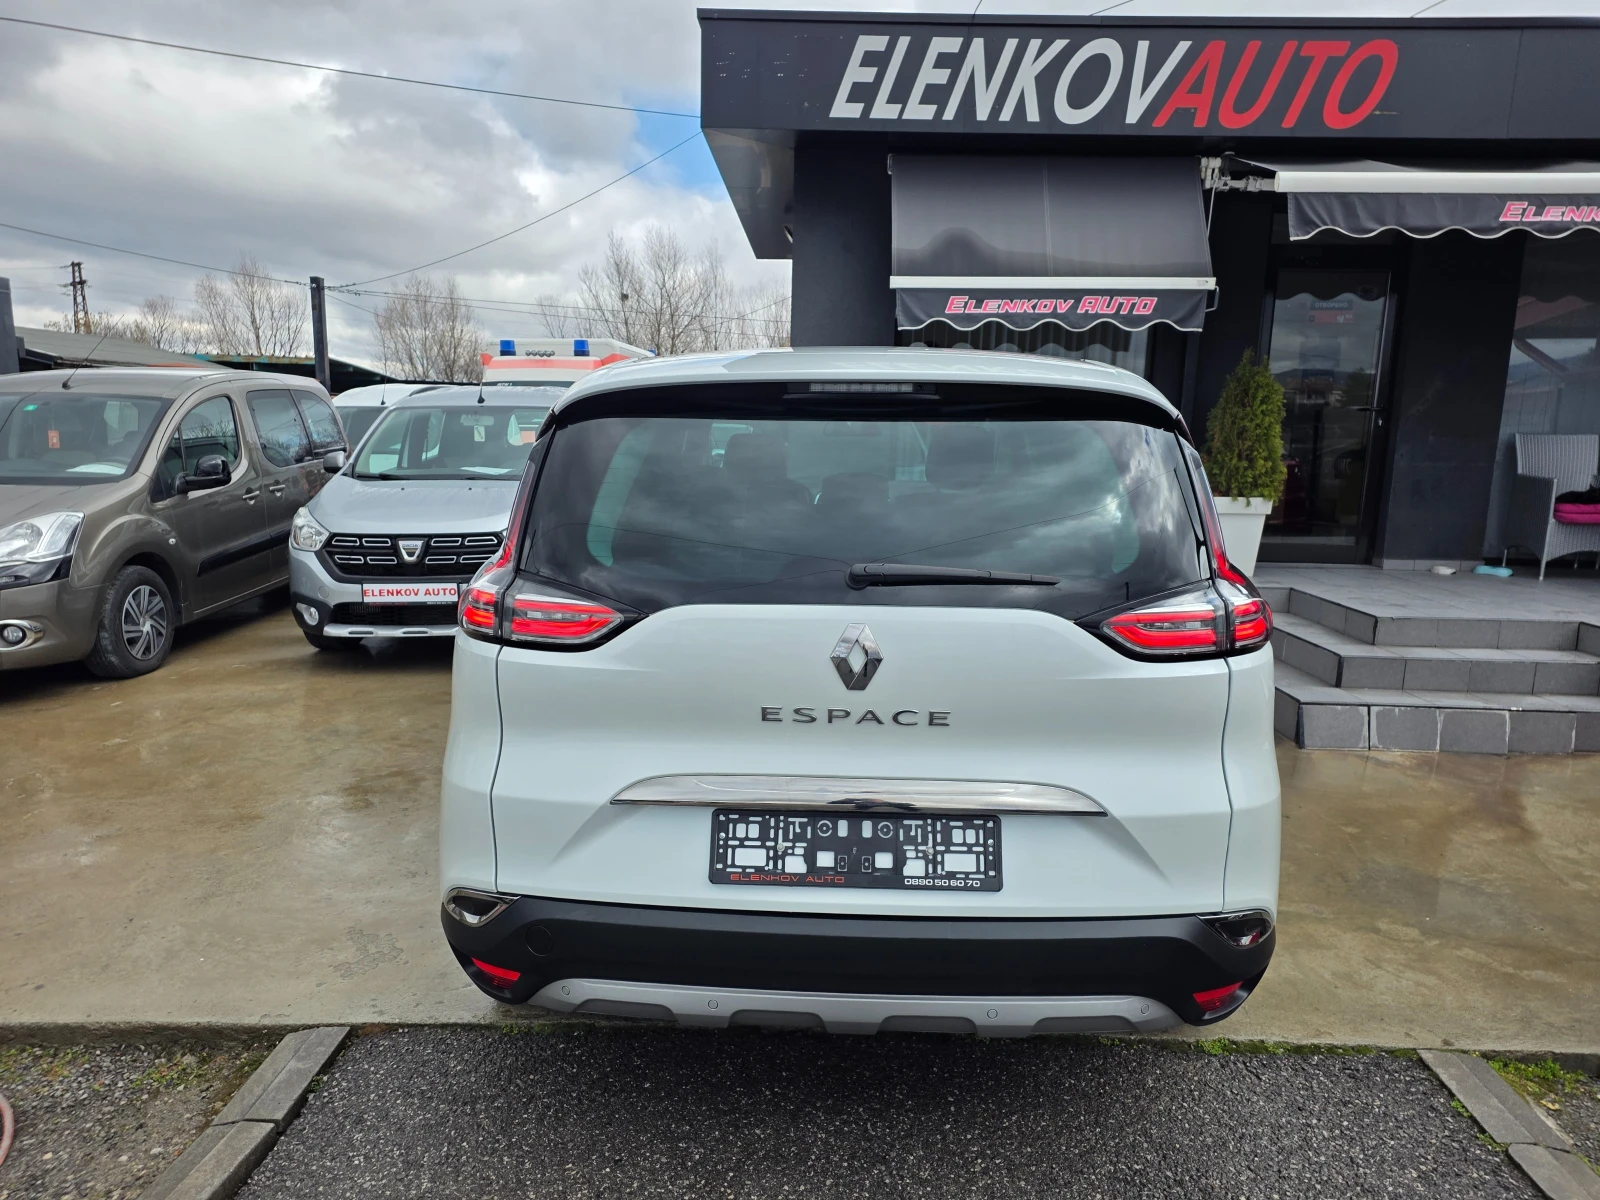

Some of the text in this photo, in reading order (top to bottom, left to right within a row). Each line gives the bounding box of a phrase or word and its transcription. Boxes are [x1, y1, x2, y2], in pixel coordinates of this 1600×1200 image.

[1077, 296, 1158, 315] AUTO
[363, 588, 457, 597] ELENKOV AUTO
[761, 705, 952, 727] ESPACE
[730, 873, 845, 883] ELENKOV AUTO
